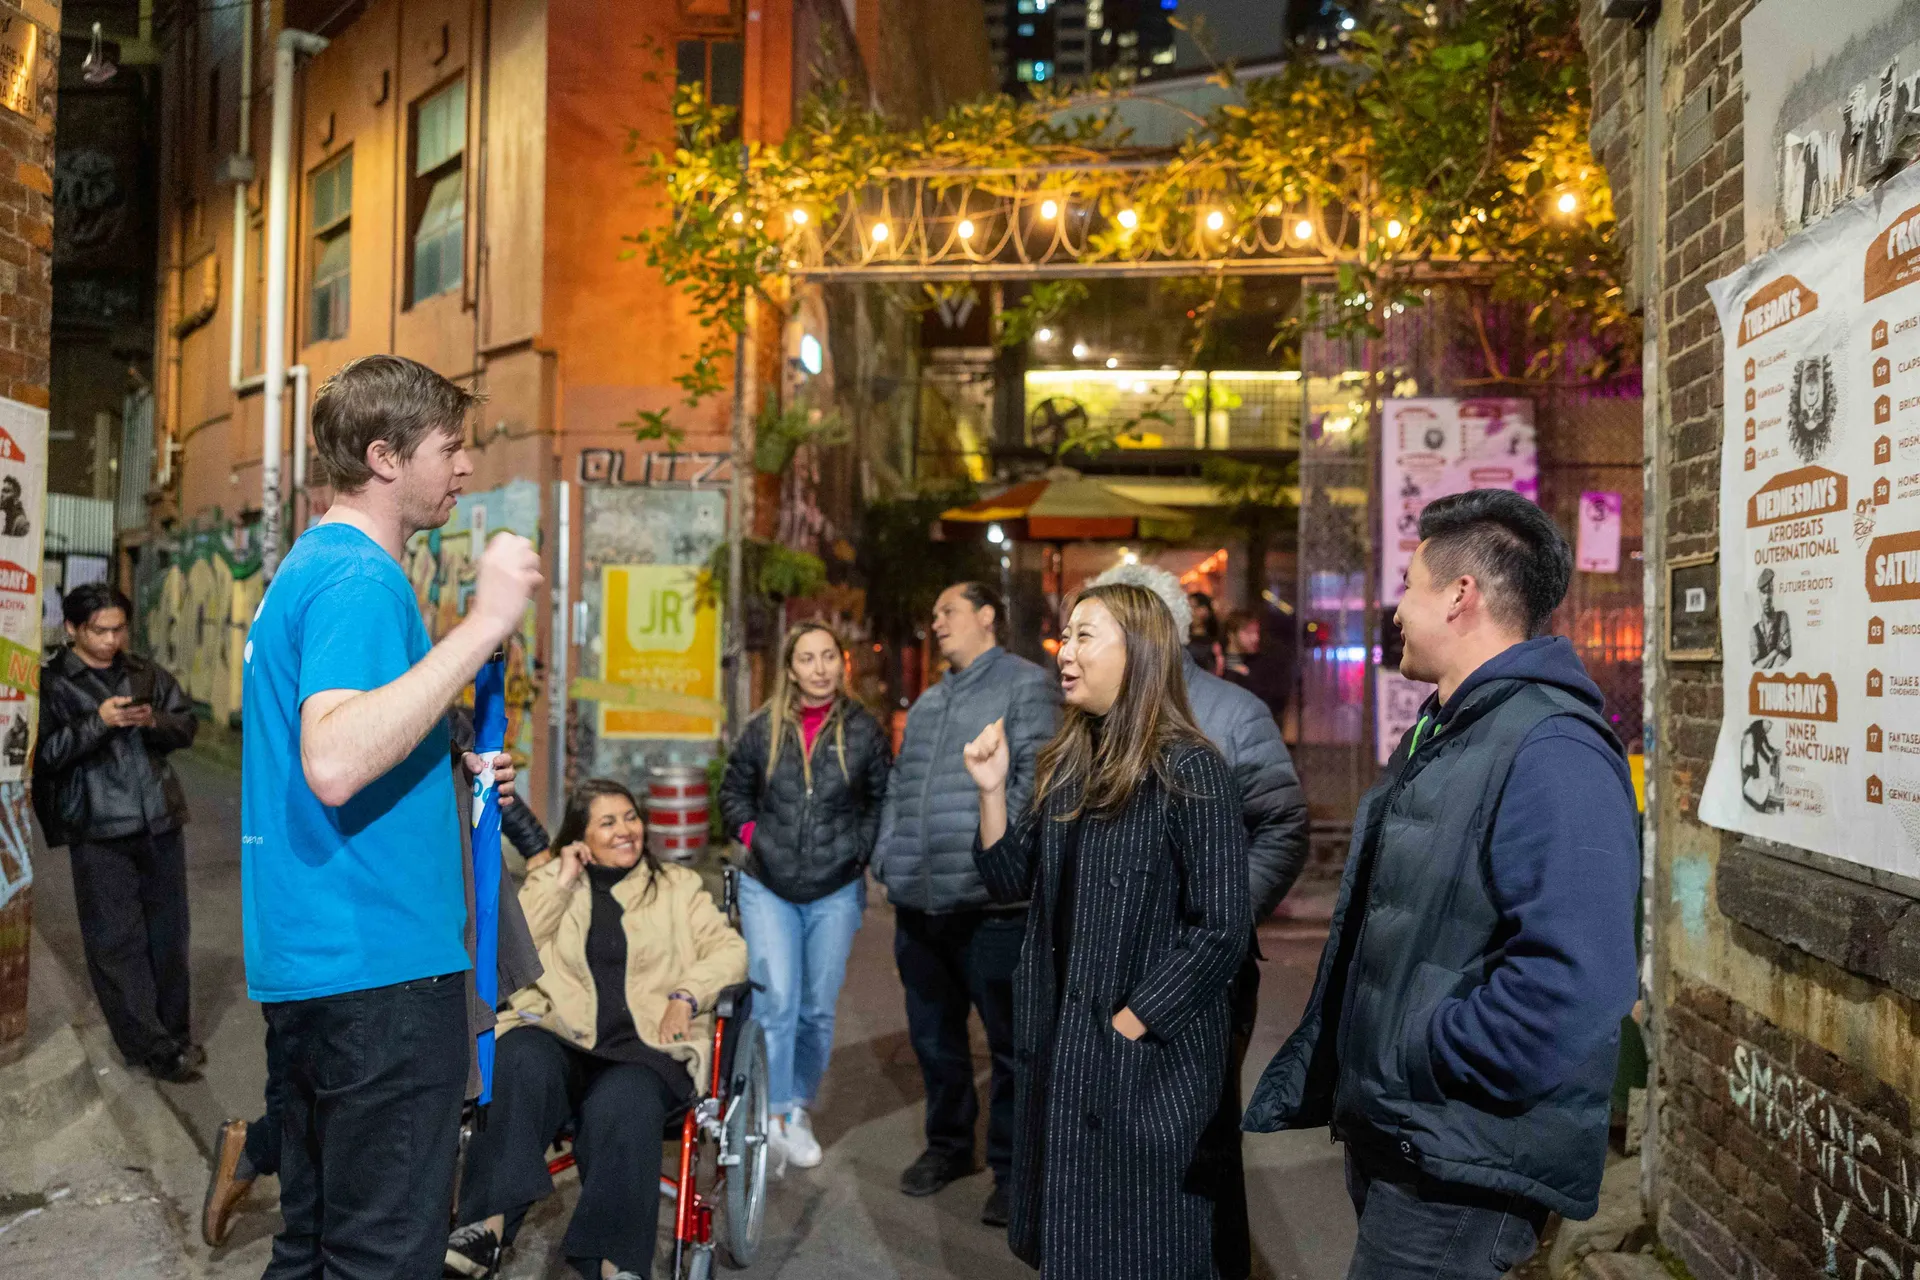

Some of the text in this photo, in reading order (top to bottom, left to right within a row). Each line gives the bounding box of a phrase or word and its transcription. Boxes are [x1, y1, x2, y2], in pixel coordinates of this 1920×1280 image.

[1744, 287, 1800, 341] TUESDAYS
[1894, 316, 1917, 334] CHRIS
[1876, 364, 1887, 377] 09
[1879, 403, 1888, 415] 16
[1756, 476, 1837, 522] WEDNESDAYS
[1877, 485, 1887, 496] 30
[1768, 518, 1824, 543] AFROBEATS
[1754, 537, 1839, 565] OUTERNATIONAL
[1779, 576, 1833, 593] FUTURE ROOTS
[638, 590, 683, 635] JR
[1757, 682, 1828, 715] THURSDAYS
[1785, 722, 1817, 741] INNER
[1870, 732, 1879, 744] 17
[1785, 740, 1849, 765] SANCTUARY
[1870, 785, 1880, 797] 24
